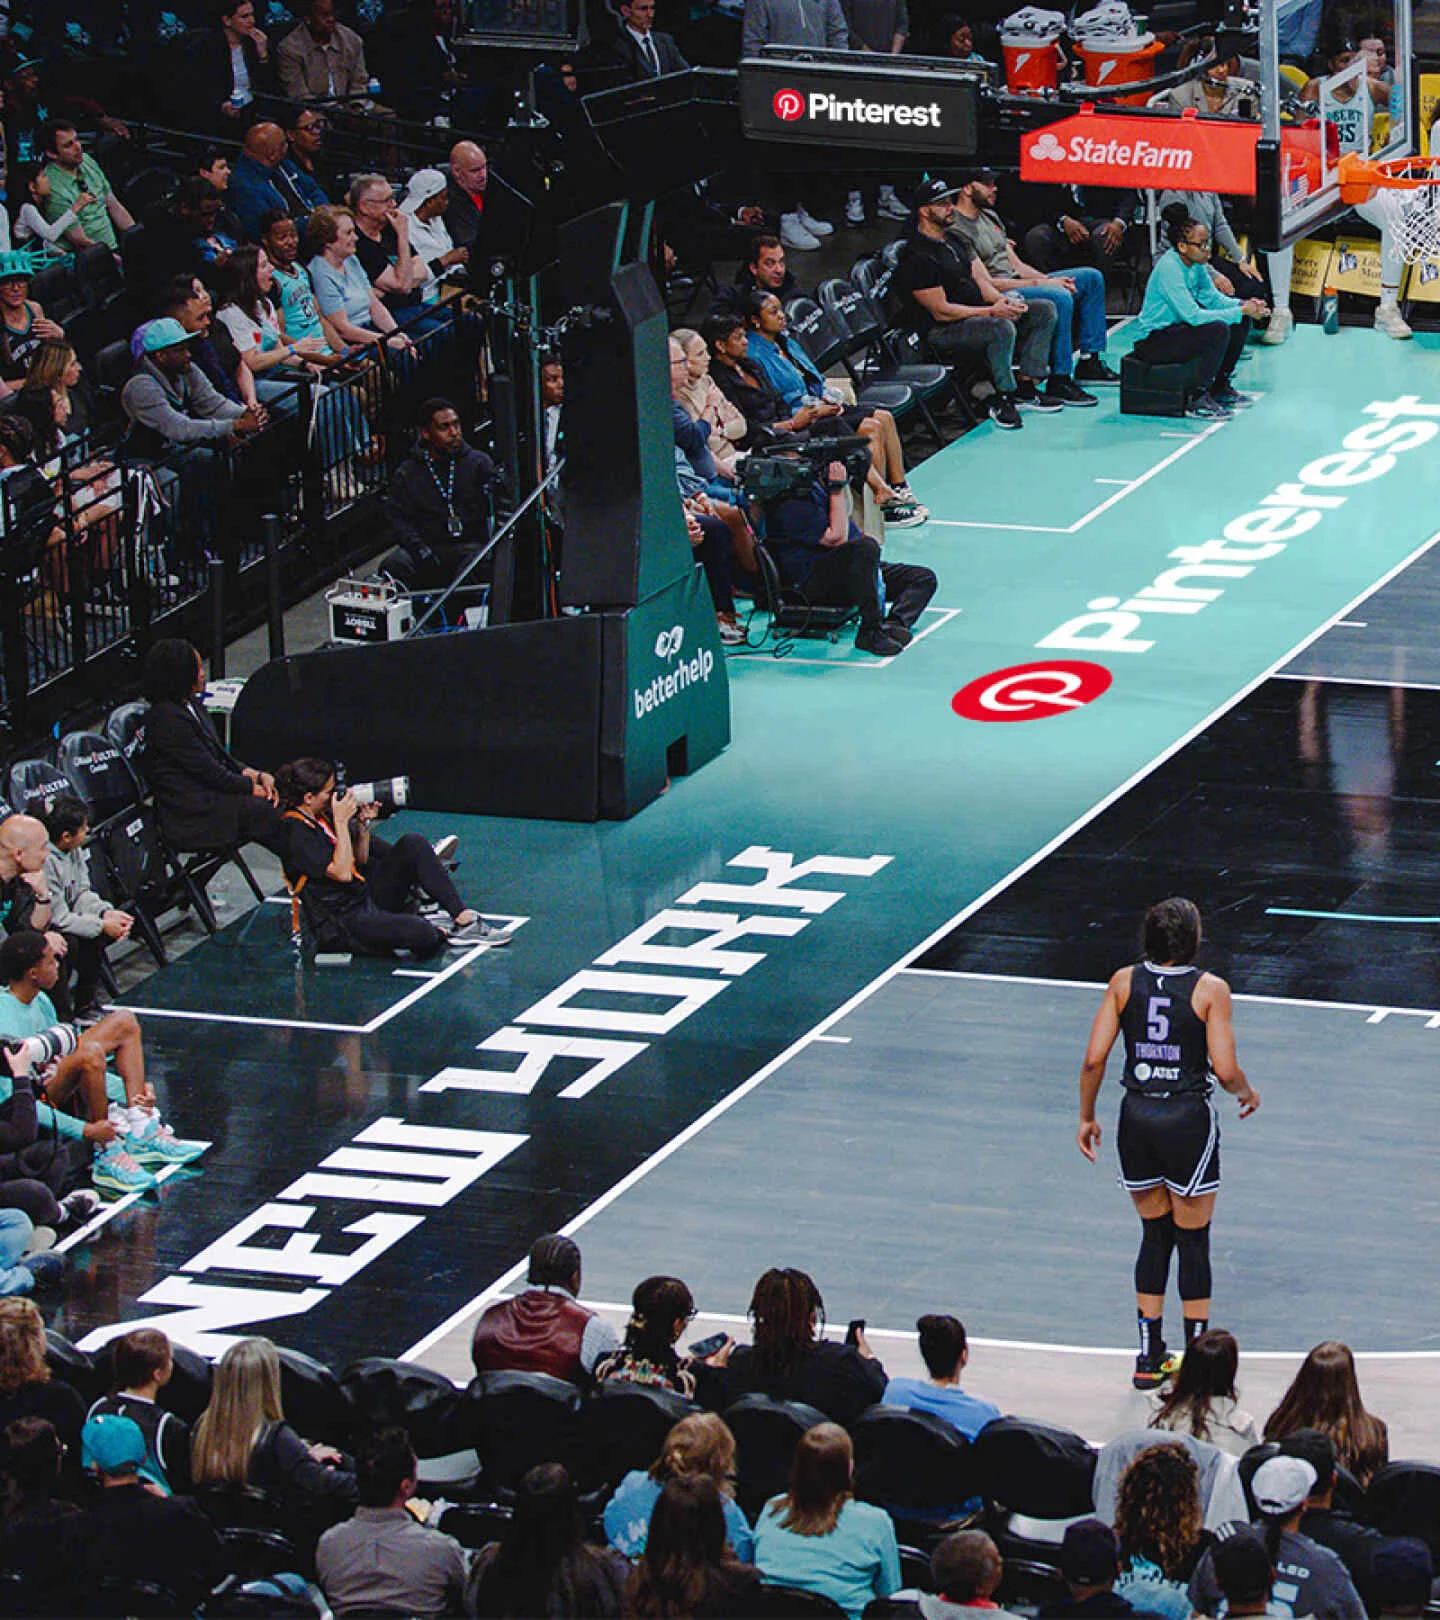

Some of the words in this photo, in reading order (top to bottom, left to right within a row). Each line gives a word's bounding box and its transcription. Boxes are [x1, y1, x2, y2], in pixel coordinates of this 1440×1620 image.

[808, 92, 942, 127] Pinterest
[634, 647, 714, 719] betterhelp
[1147, 996, 1171, 1041] 5
[1135, 1042, 1181, 1061] THORNTON
[1152, 1066, 1180, 1081] AT&T
[75, 1116, 532, 1358] NEW
[419, 845, 895, 1098] YORK
